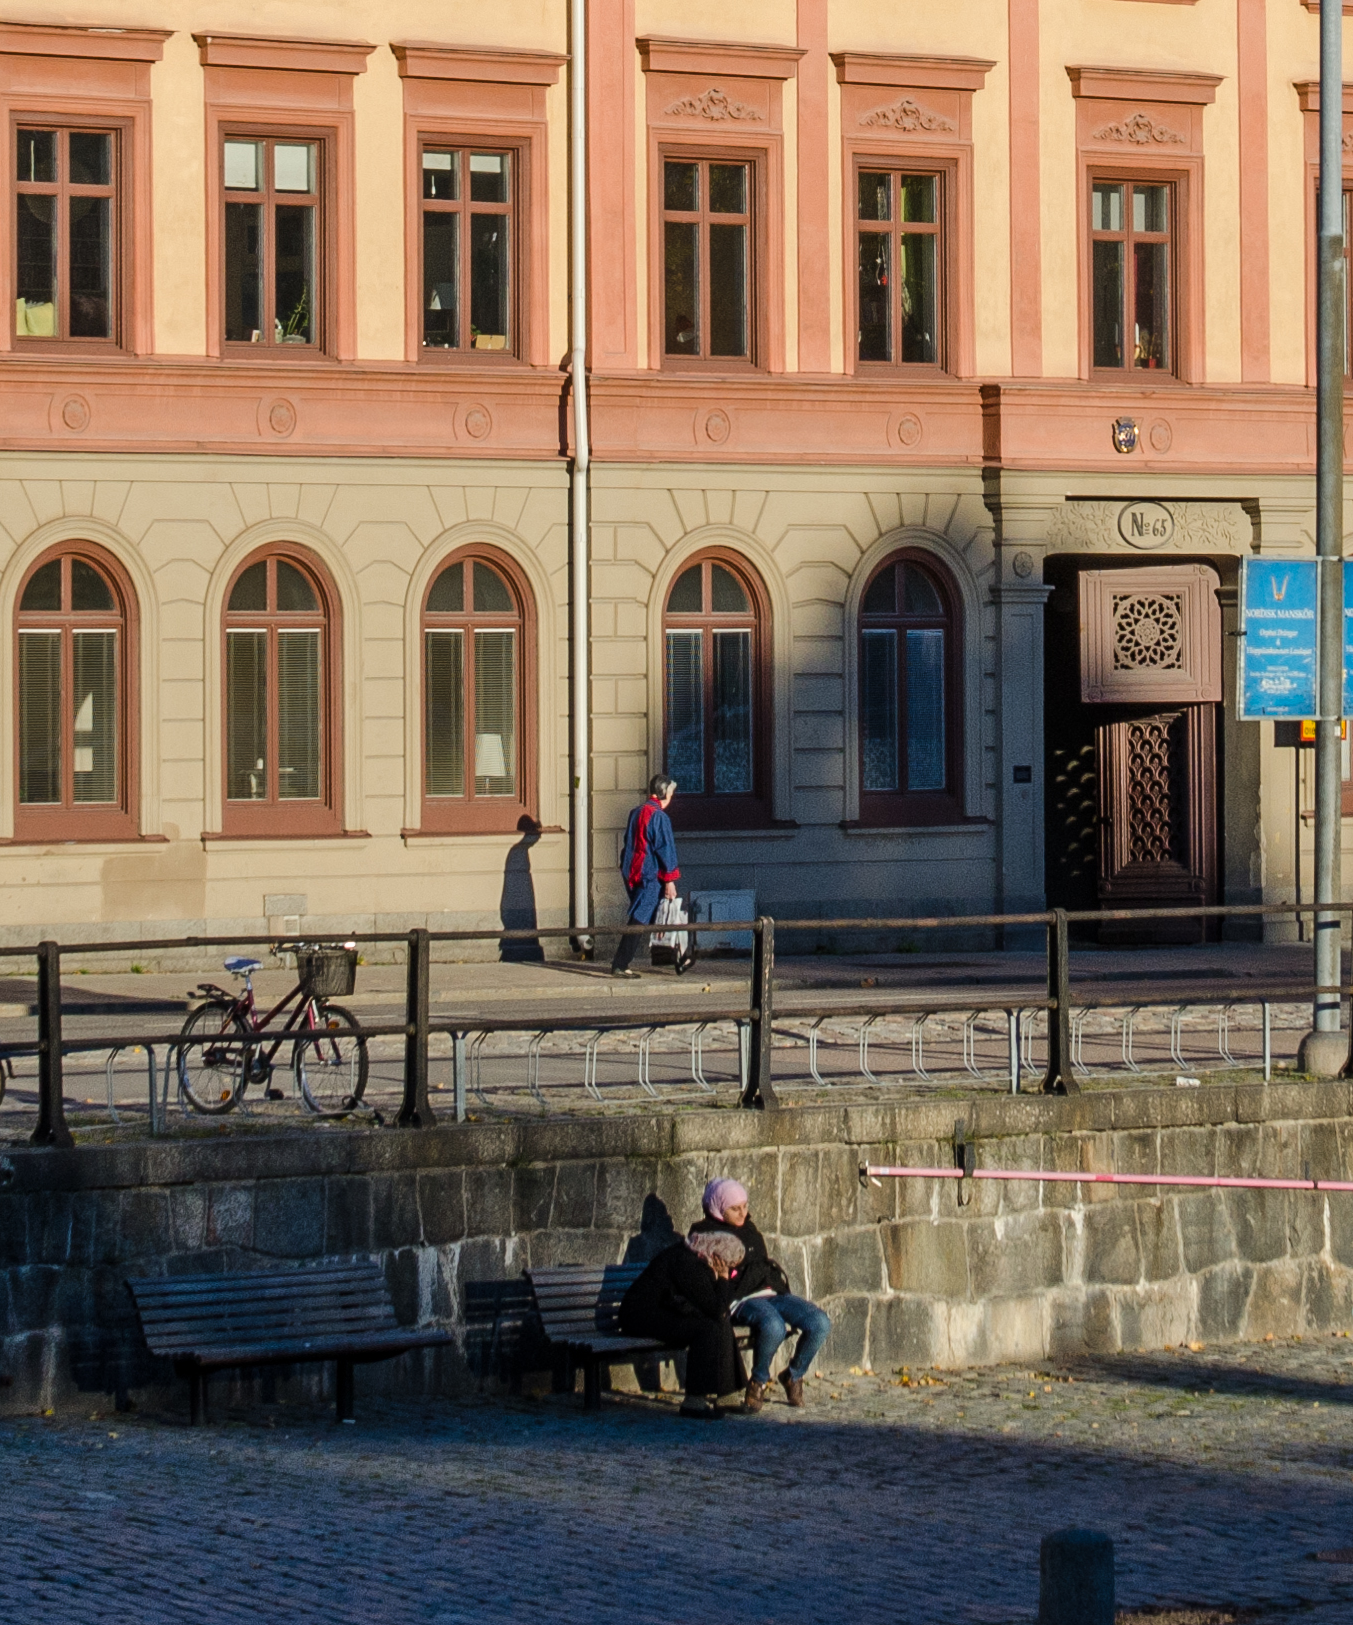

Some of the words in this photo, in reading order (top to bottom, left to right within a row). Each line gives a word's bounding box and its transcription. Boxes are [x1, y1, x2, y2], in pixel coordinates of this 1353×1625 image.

[1152, 518, 1168, 537] 65
[1246, 608, 1276, 619] NORDISK
[1278, 607, 1314, 619] MANSKÖR
